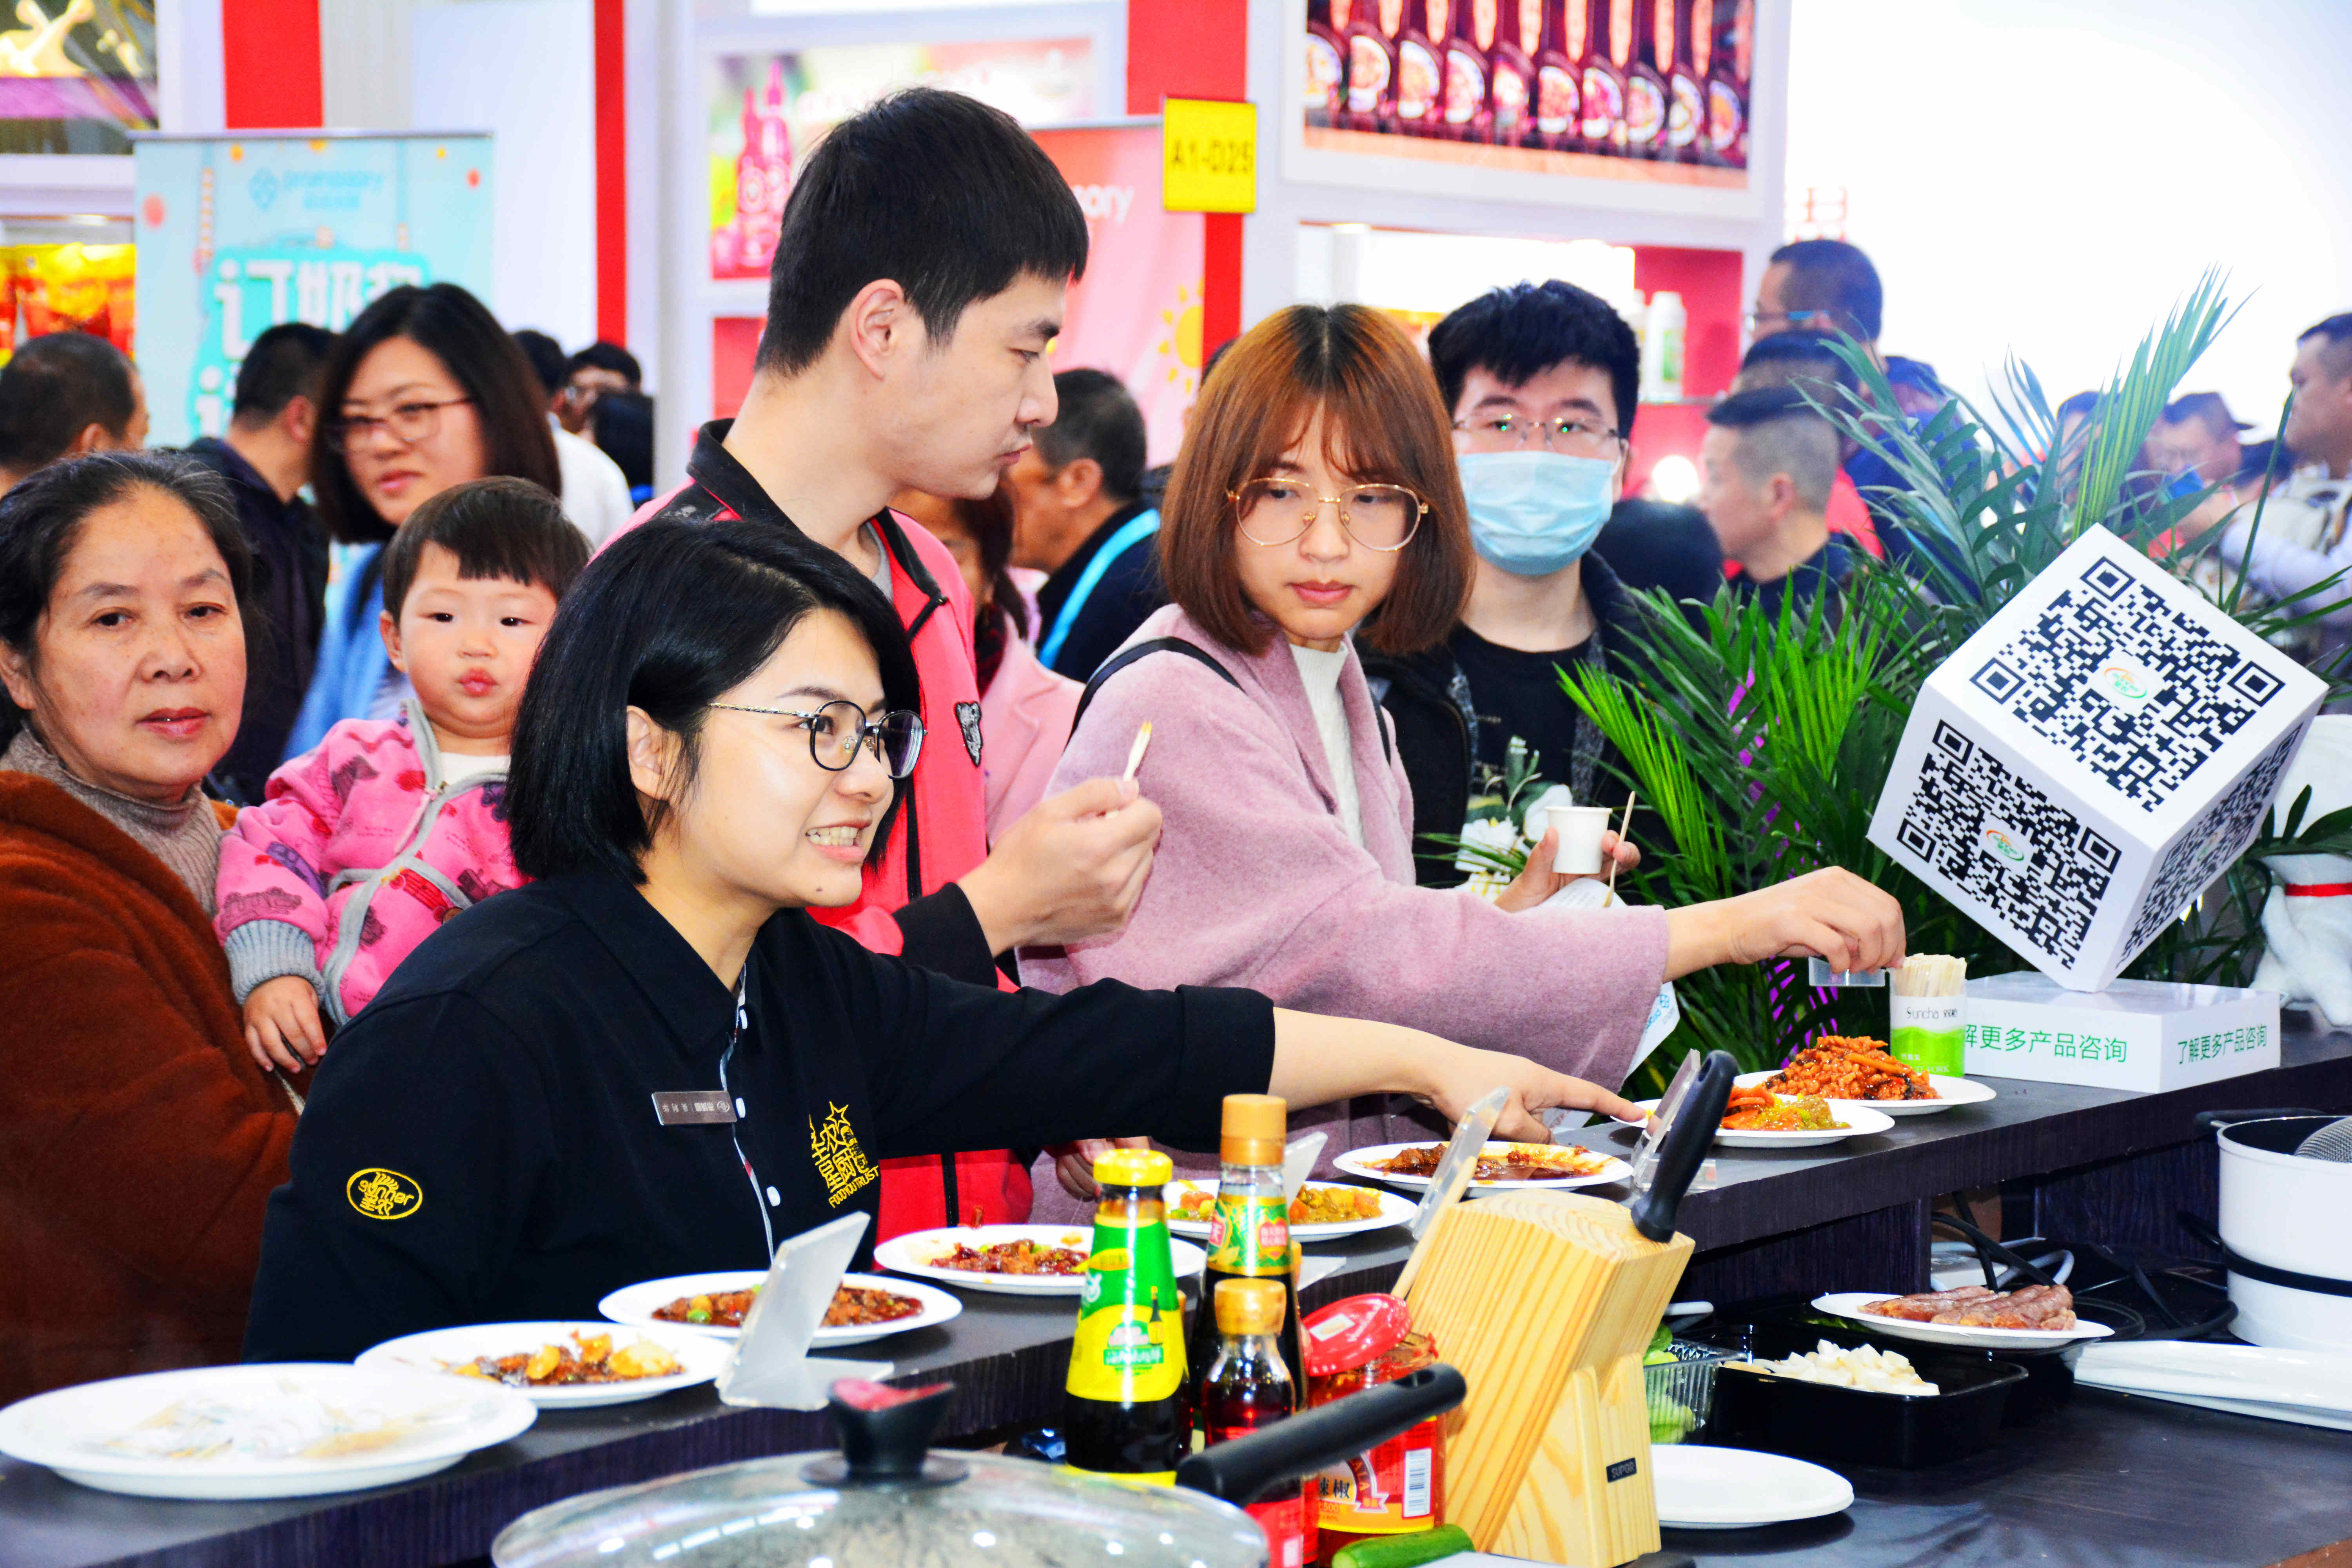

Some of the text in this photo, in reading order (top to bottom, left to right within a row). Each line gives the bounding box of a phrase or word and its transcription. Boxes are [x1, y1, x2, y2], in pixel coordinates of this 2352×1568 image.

[1906, 1007, 1939, 1019] Suncha
[2178, 1024, 2267, 1064] 了解更多产品咨询
